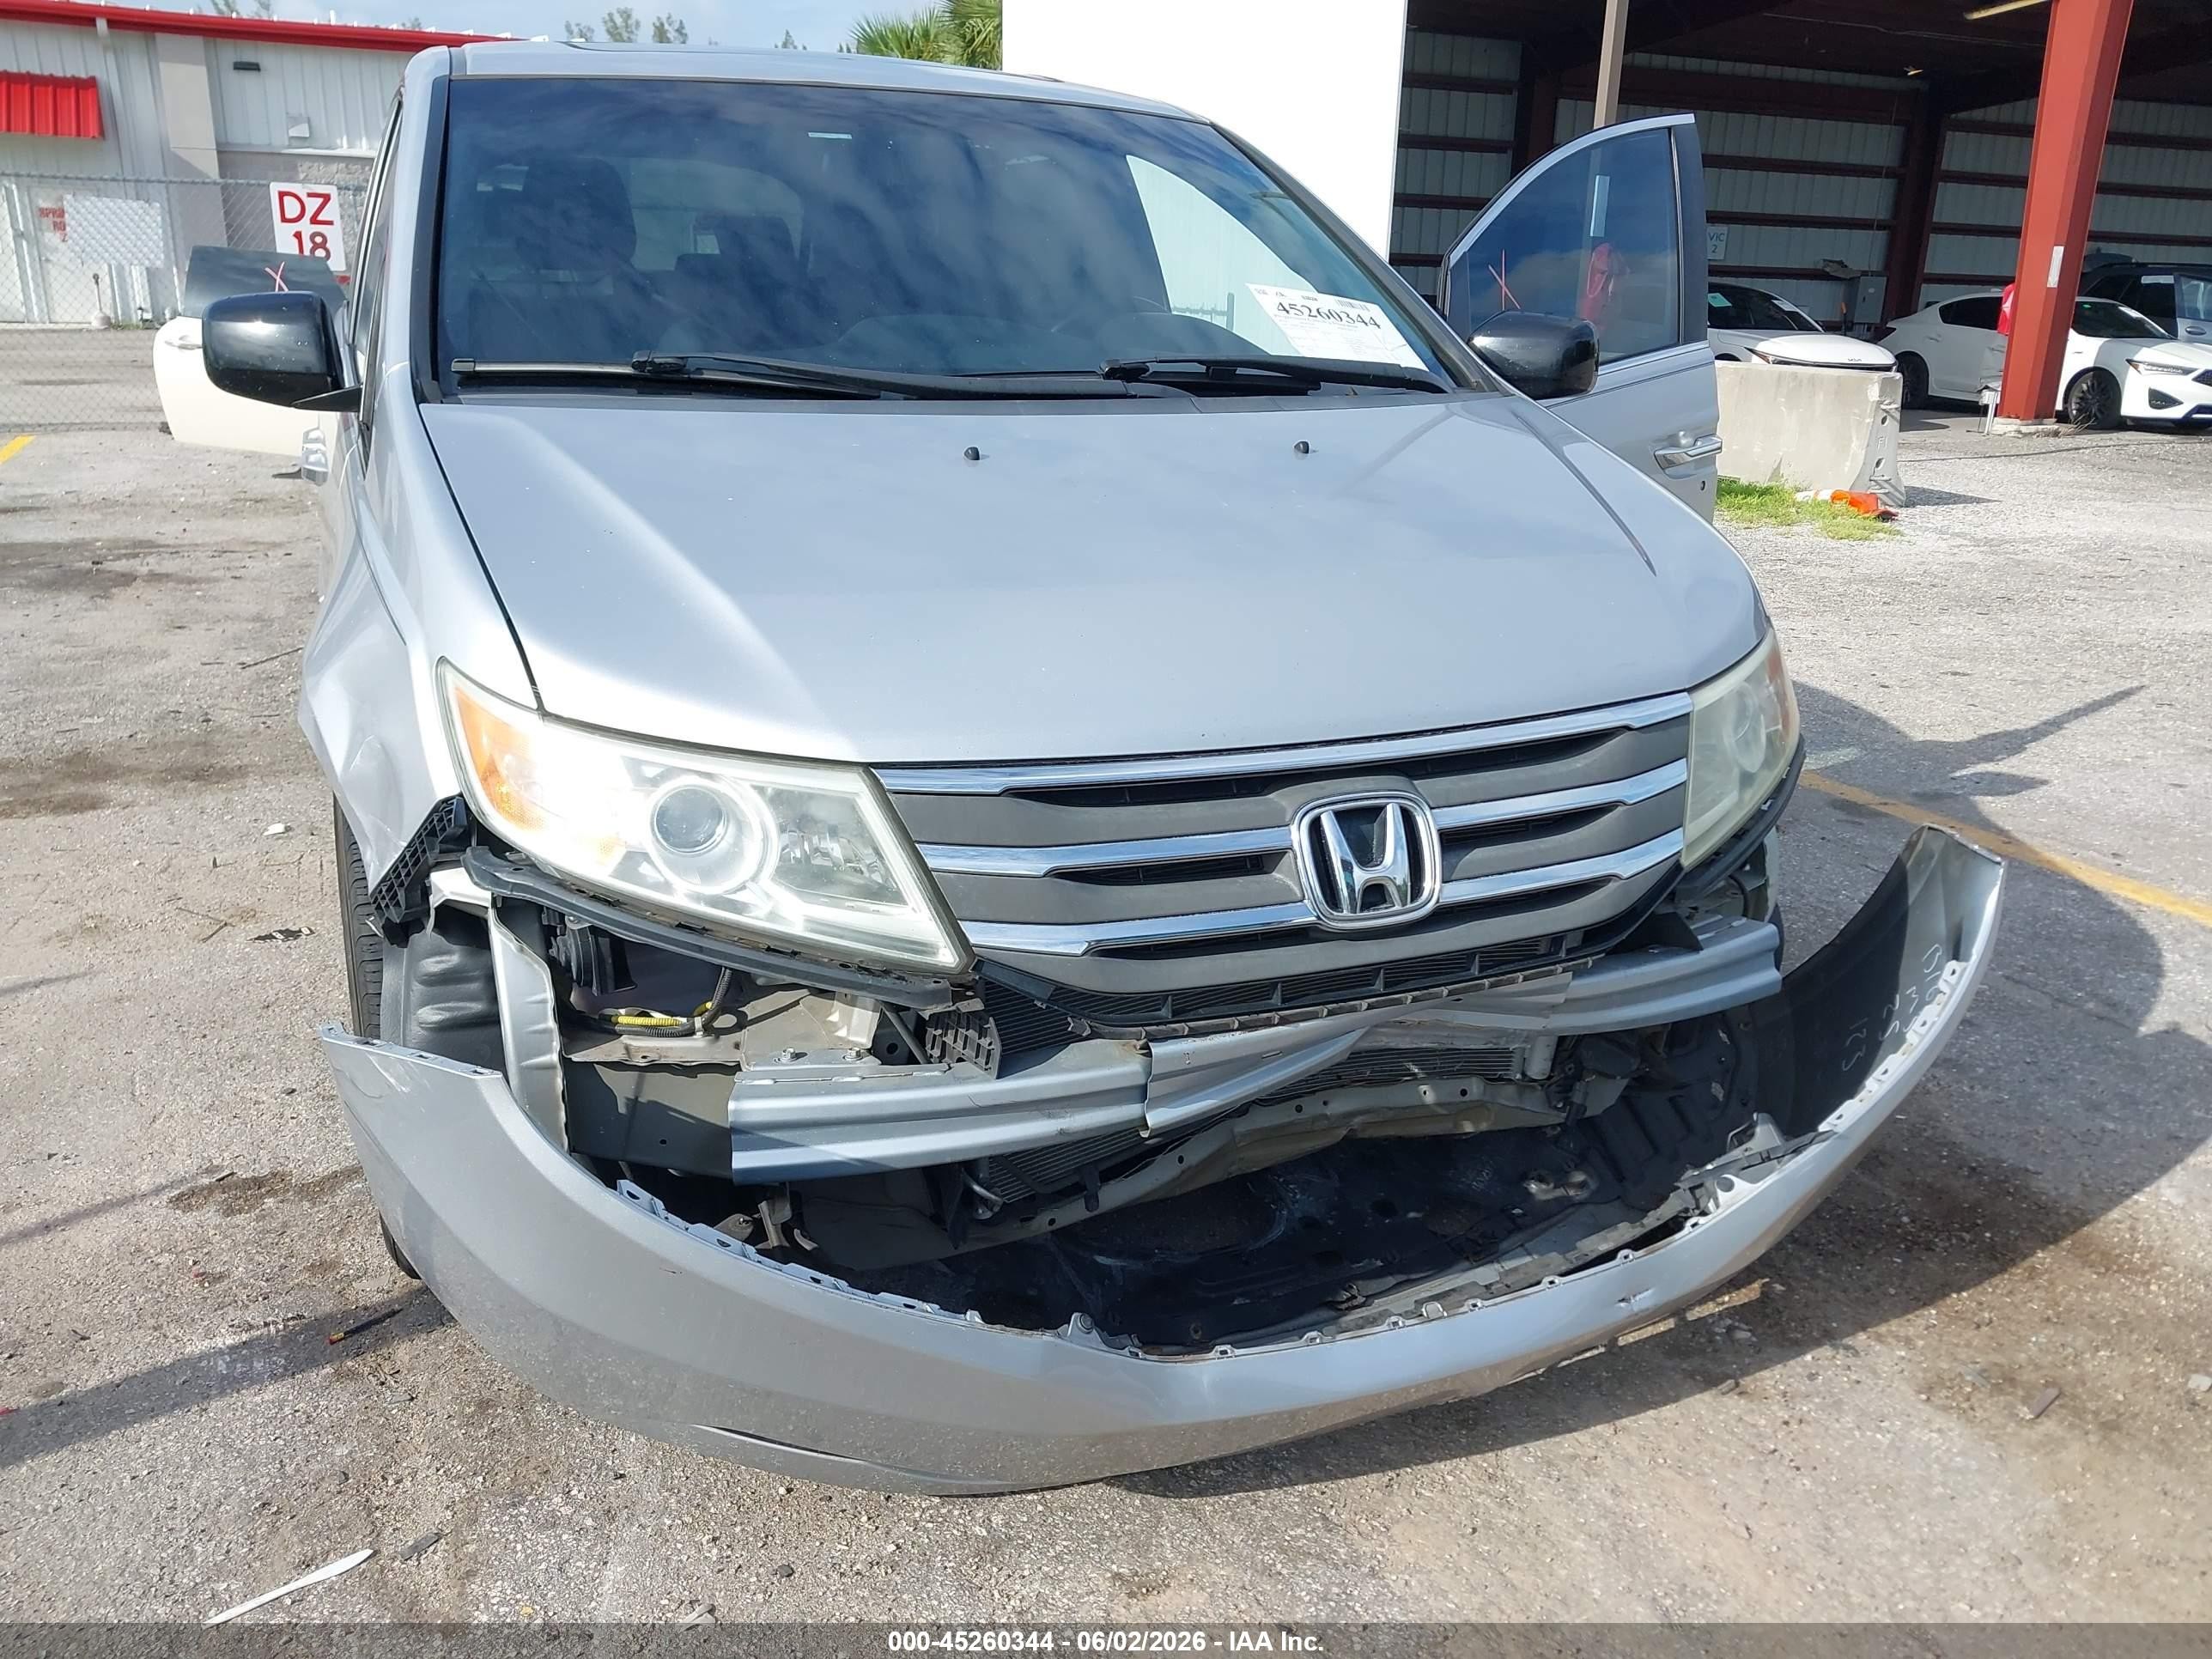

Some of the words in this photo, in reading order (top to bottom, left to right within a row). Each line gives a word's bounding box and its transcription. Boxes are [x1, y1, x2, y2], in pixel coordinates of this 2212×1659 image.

[277, 190, 334, 226] DZ
[293, 230, 331, 261] 18
[1708, 232, 1725, 242] VIC
[1276, 301, 1382, 329] 45260344
